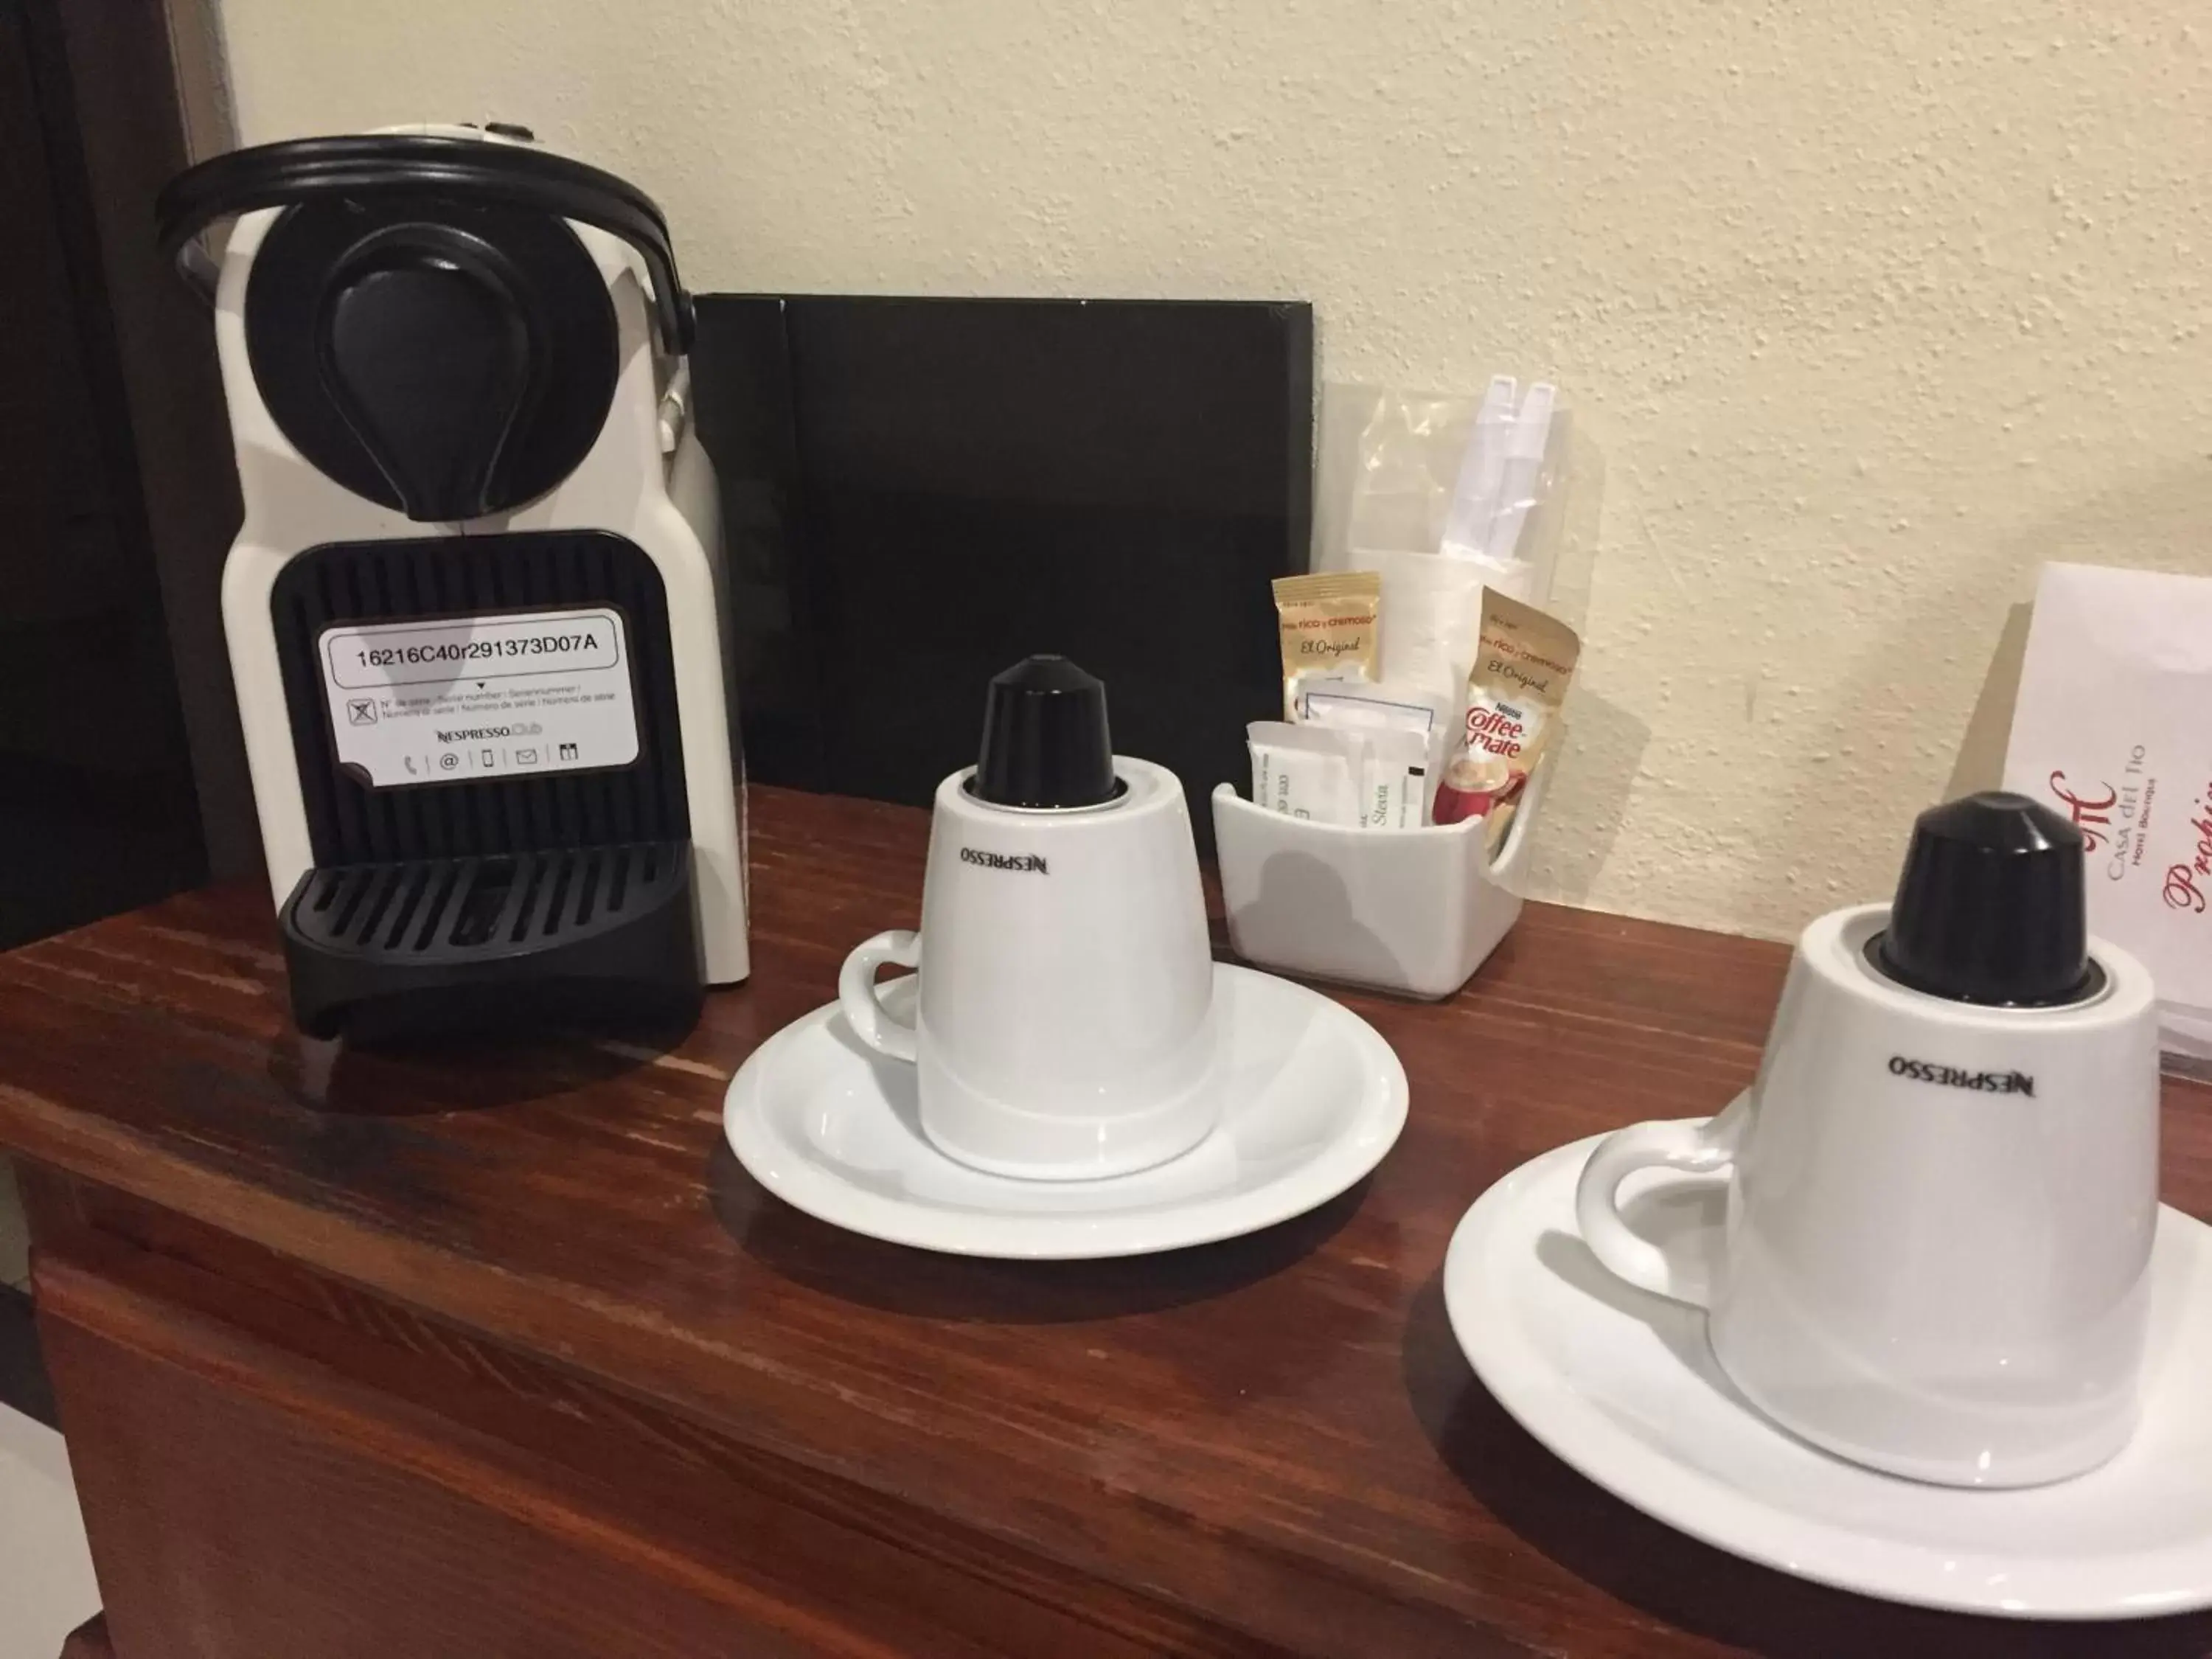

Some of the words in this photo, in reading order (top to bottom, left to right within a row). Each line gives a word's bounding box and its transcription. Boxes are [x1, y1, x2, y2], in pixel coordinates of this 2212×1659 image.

[1298, 619, 1321, 629] rico
[1301, 640, 1314, 655] El
[1316, 636, 1360, 657] Original
[1487, 660, 1503, 674] El
[1503, 665, 1549, 694] Original
[437, 726, 510, 744] NESPRESSO
[960, 847, 1051, 876] NESPRESSO
[1888, 1056, 2037, 1098] NESPRESSO
